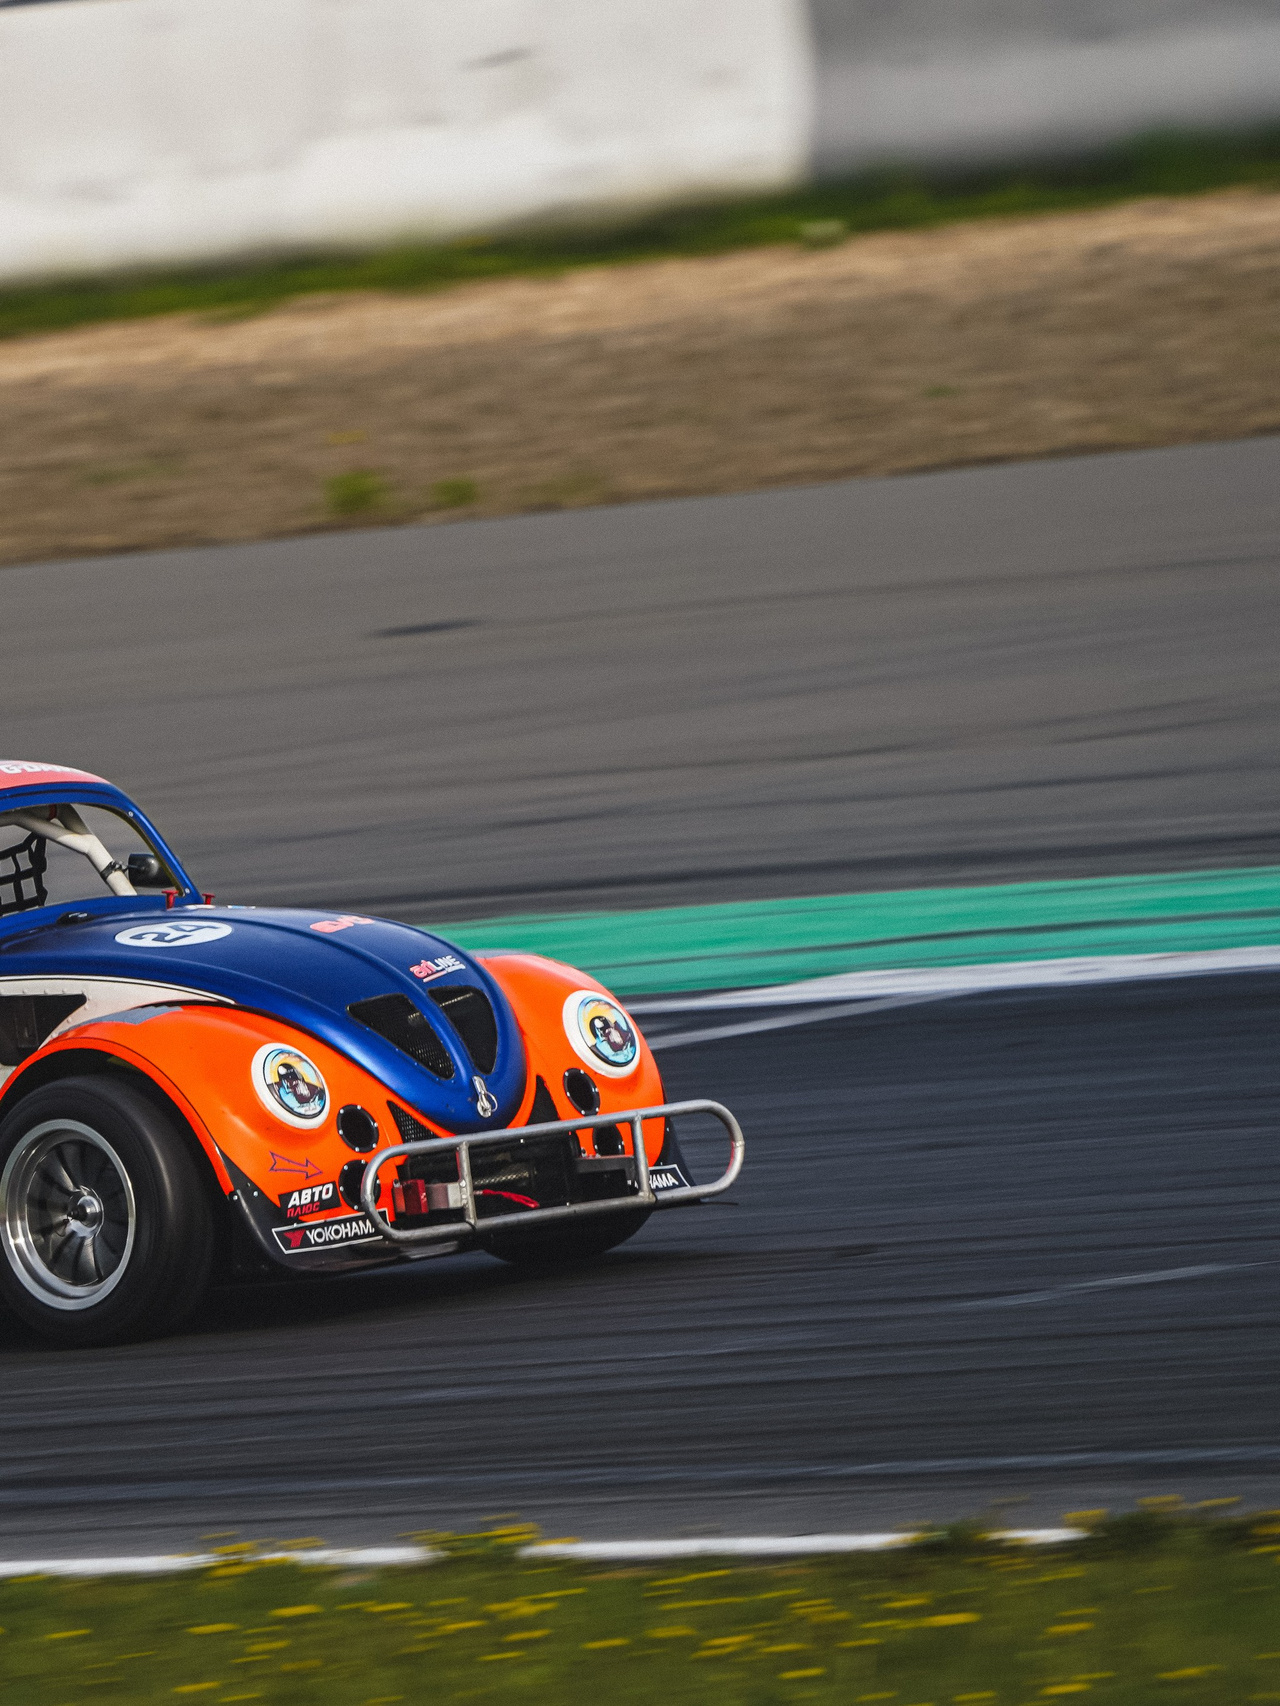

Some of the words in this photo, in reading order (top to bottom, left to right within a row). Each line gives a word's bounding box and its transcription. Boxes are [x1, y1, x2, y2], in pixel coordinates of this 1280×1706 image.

[129, 924, 220, 943] 24
[288, 1183, 333, 1208] АВТО
[287, 1202, 320, 1218] ПЛЮС
[305, 1219, 375, 1244] YOKOHAM
